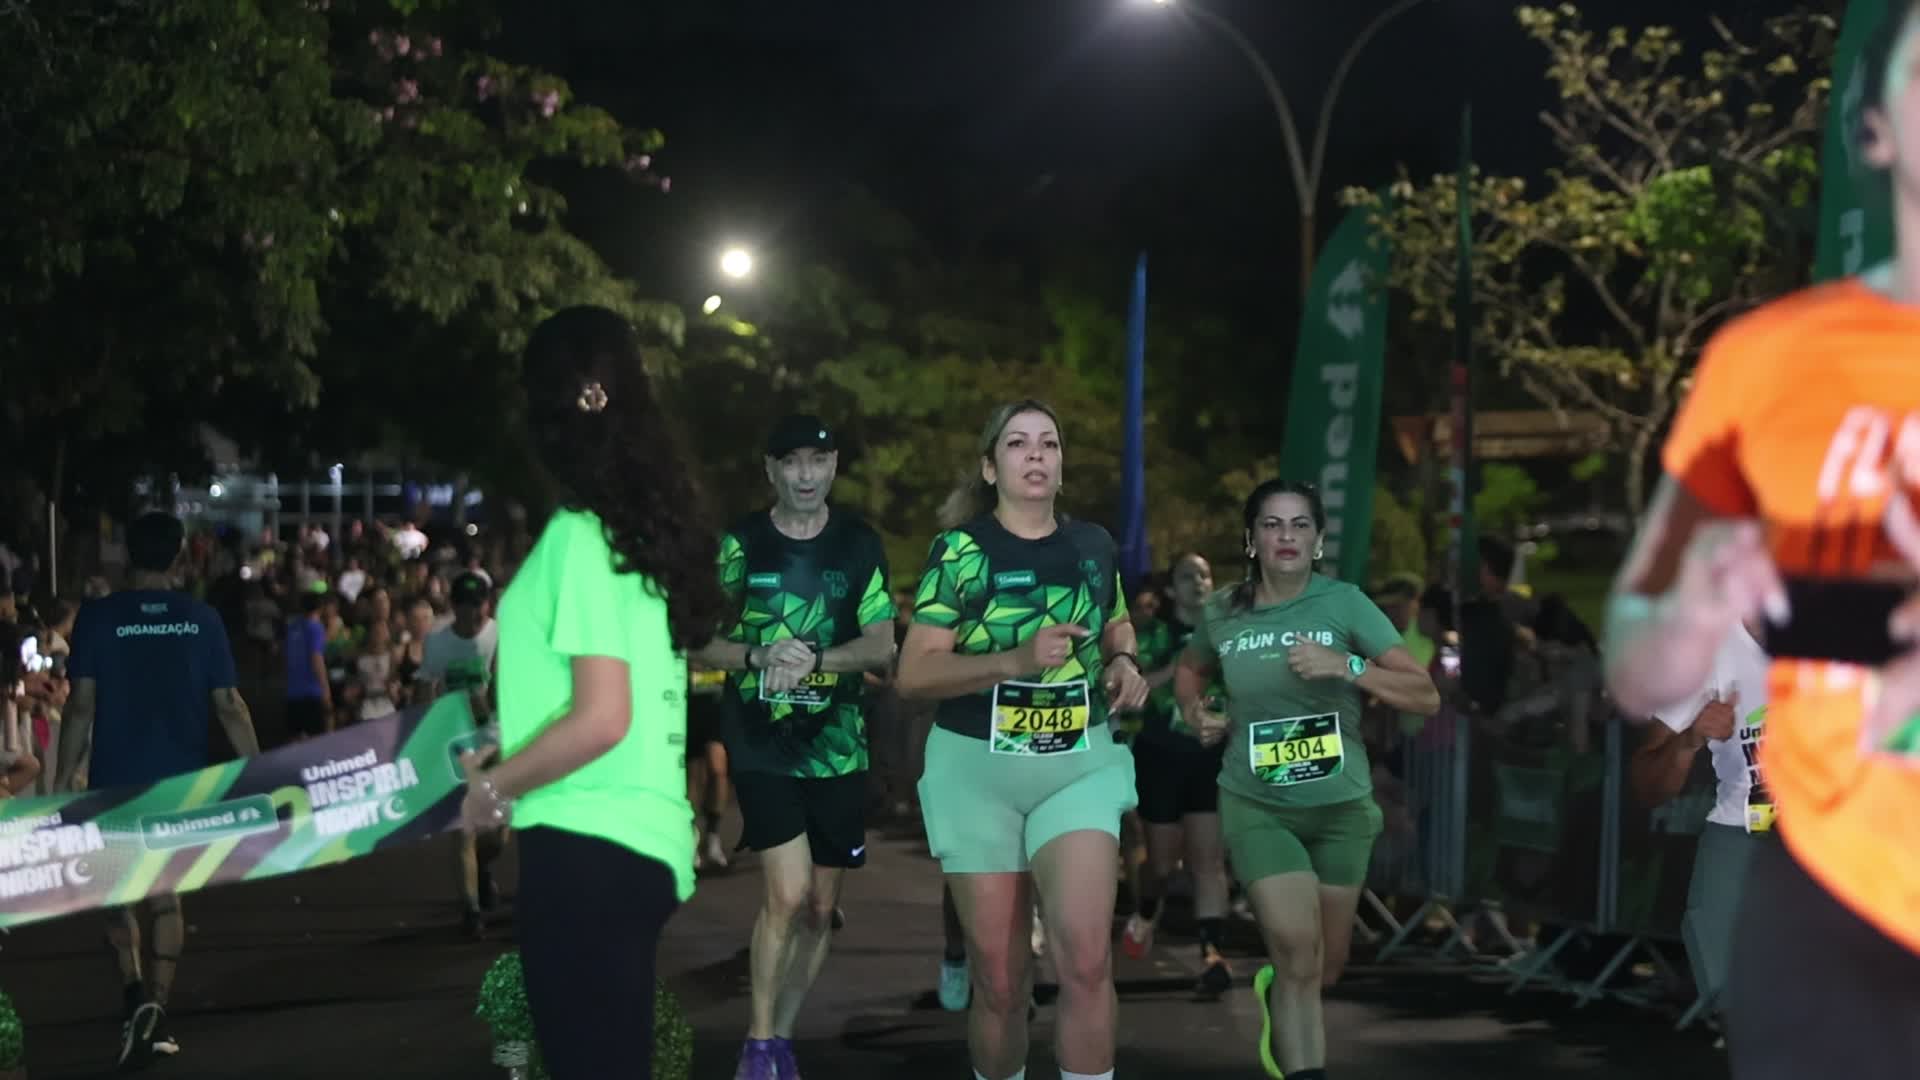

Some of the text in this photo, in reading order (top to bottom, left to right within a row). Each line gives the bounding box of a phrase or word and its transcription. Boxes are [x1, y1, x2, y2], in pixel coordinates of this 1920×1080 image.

[116, 620, 199, 637] ORGANIZAÇÃO
[1236, 632, 1275, 652] RUN
[1013, 708, 1073, 731] 2048
[1270, 736, 1326, 763] 1304
[303, 748, 378, 782] Unimed
[308, 757, 419, 807] INSPIRA
[153, 811, 236, 838] Unimed
[314, 800, 379, 836] NIGHT
